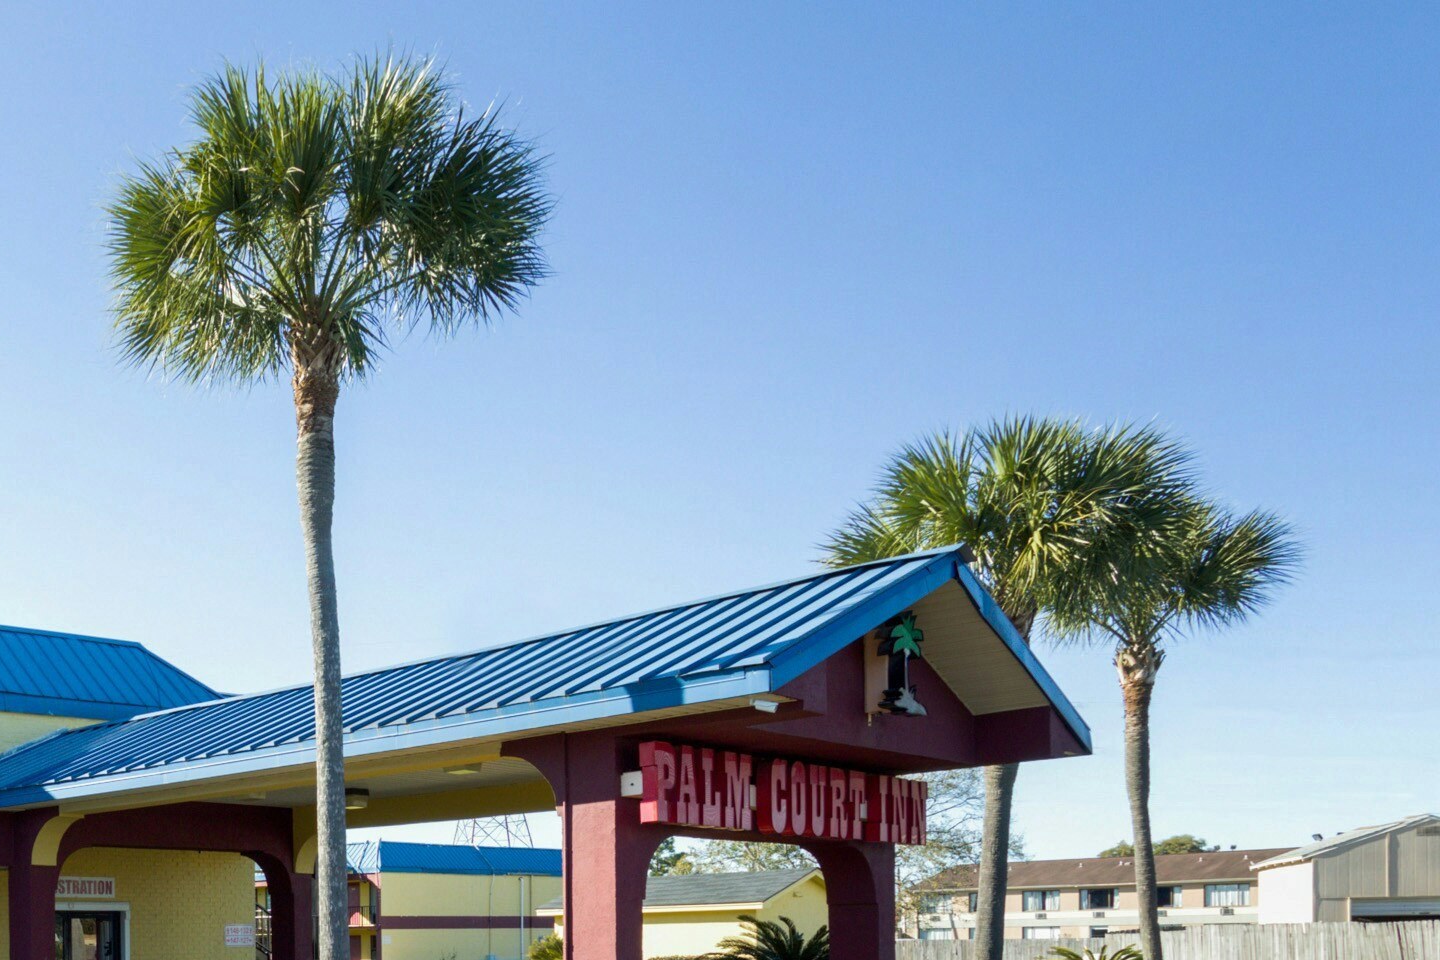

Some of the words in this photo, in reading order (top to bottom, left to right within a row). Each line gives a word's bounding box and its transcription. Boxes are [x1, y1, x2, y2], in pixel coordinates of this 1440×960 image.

[653, 741, 753, 831] PALM
[771, 758, 867, 839] COURT
[879, 774, 928, 845] INN
[56, 879, 113, 895] STRATION
